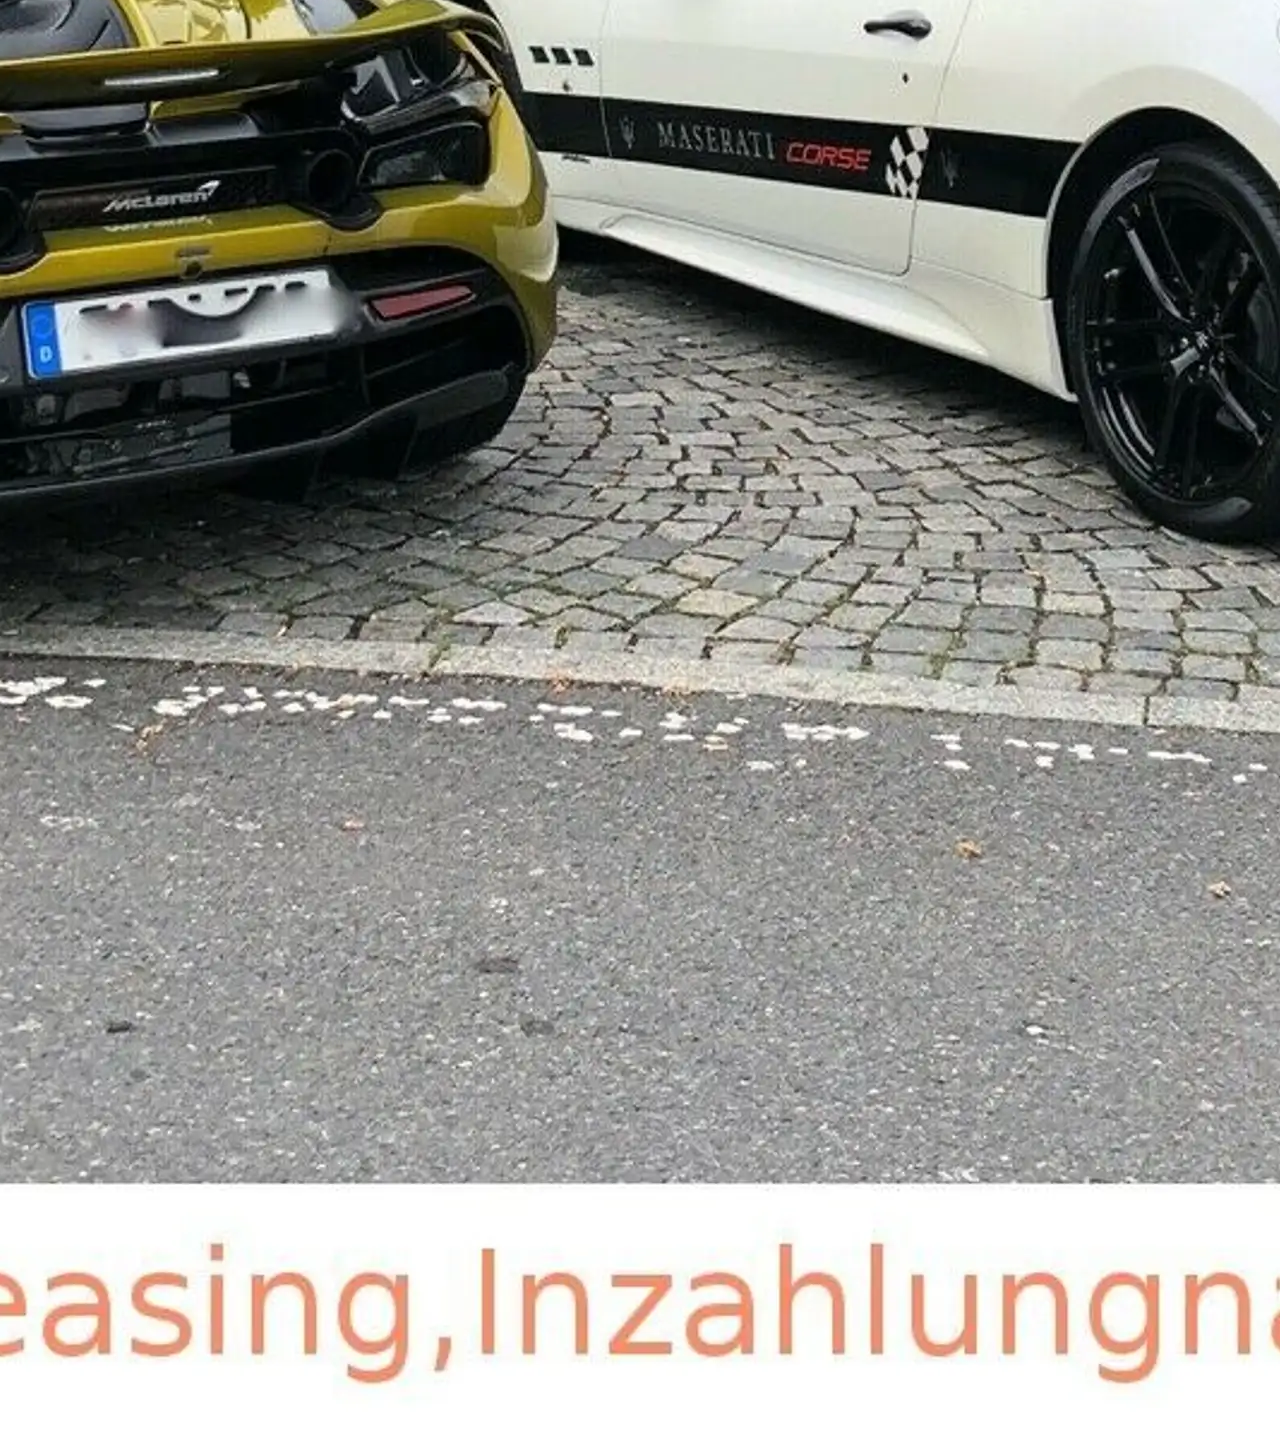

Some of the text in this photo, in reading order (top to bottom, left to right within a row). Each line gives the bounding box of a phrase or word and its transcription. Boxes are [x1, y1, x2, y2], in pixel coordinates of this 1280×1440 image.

[657, 122, 871, 171] MASERATI CORSE
[102, 189, 210, 213] McLaren
